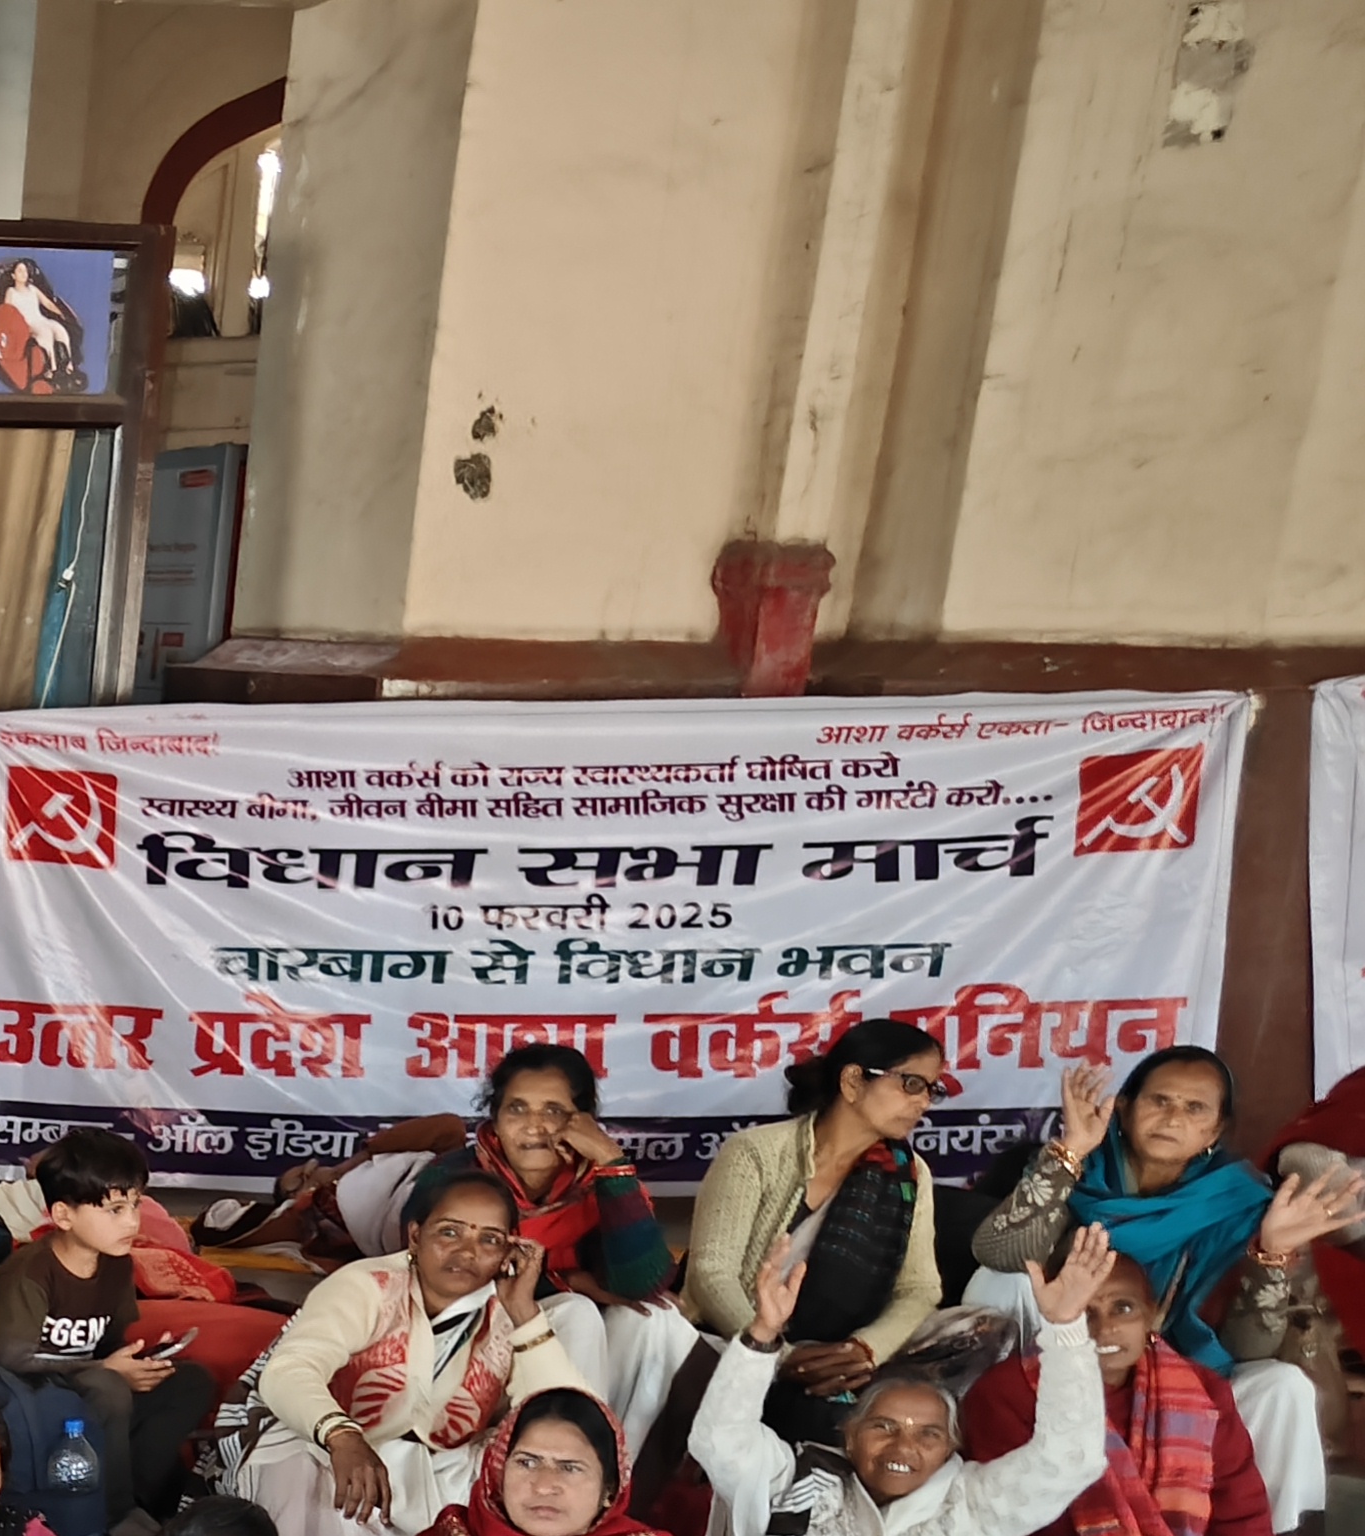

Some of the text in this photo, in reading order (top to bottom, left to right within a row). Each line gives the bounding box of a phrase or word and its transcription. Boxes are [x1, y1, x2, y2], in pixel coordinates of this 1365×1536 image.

[288, 752, 900, 789] आशा वर्कर्स को राज्य स्वास्थ्यकर्ता घोषित करो
[139, 796, 239, 818] स्वास्थ्य
[245, 793, 318, 821] बीमा,
[328, 793, 407, 818] जीवन
[416, 793, 478, 818] बीमा
[486, 792, 564, 818] सहित
[572, 789, 708, 817] सामाजिक
[716, 792, 797, 822] सुरक्षा
[804, 784, 847, 812] की
[855, 780, 938, 810] गारंटी
[136, 815, 1054, 889] विधान सभा मार्च
[429, 893, 733, 931] 10 फरवरी 2025
[469, 938, 537, 985] से
[553, 938, 762, 985] विधान
[776, 942, 953, 980] भवन
[188, 990, 372, 1079] प्रदेश
[147, 1111, 239, 1154] ऑल
[244, 1117, 360, 1160] इंडिया
